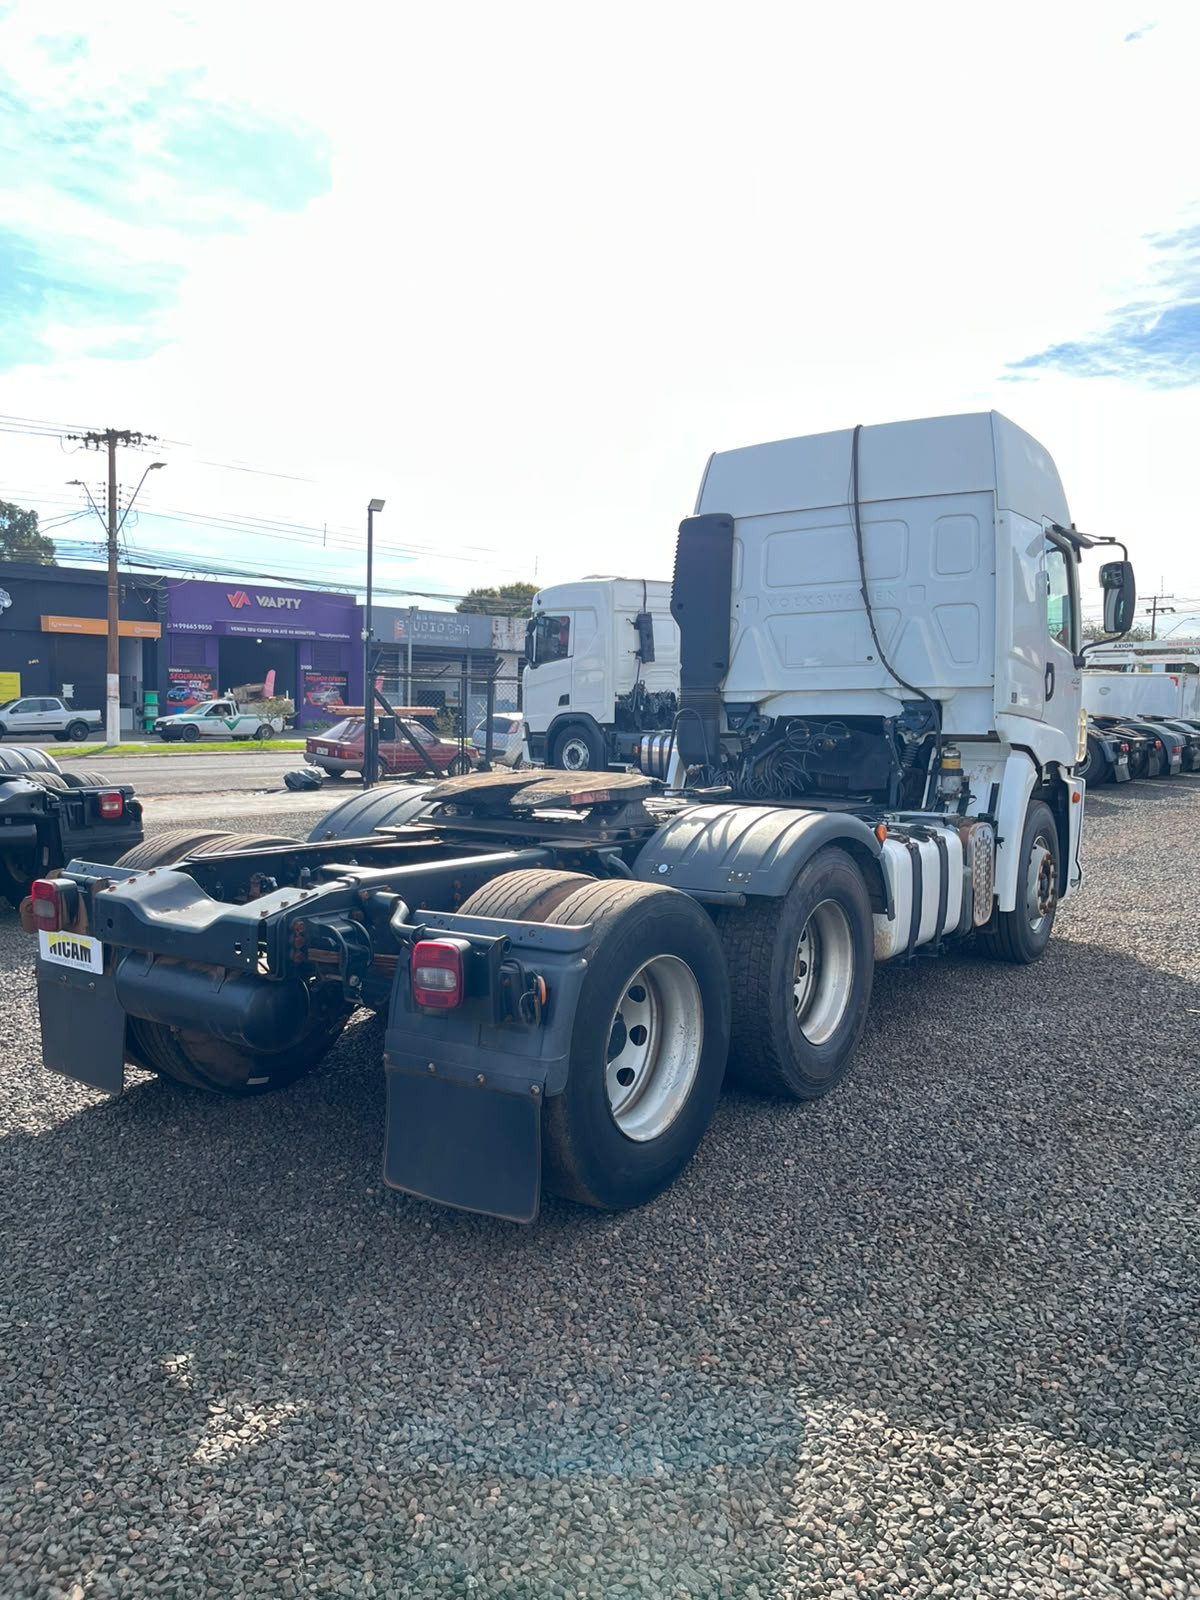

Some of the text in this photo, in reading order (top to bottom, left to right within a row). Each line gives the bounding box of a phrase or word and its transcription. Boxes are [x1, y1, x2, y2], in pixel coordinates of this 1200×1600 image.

[256, 595, 302, 609] VAPTY
[767, 590, 897, 608] VOLKSWAEN
[169, 672, 212, 682] SEGURANÇA
[48, 932, 92, 963] NICAM
